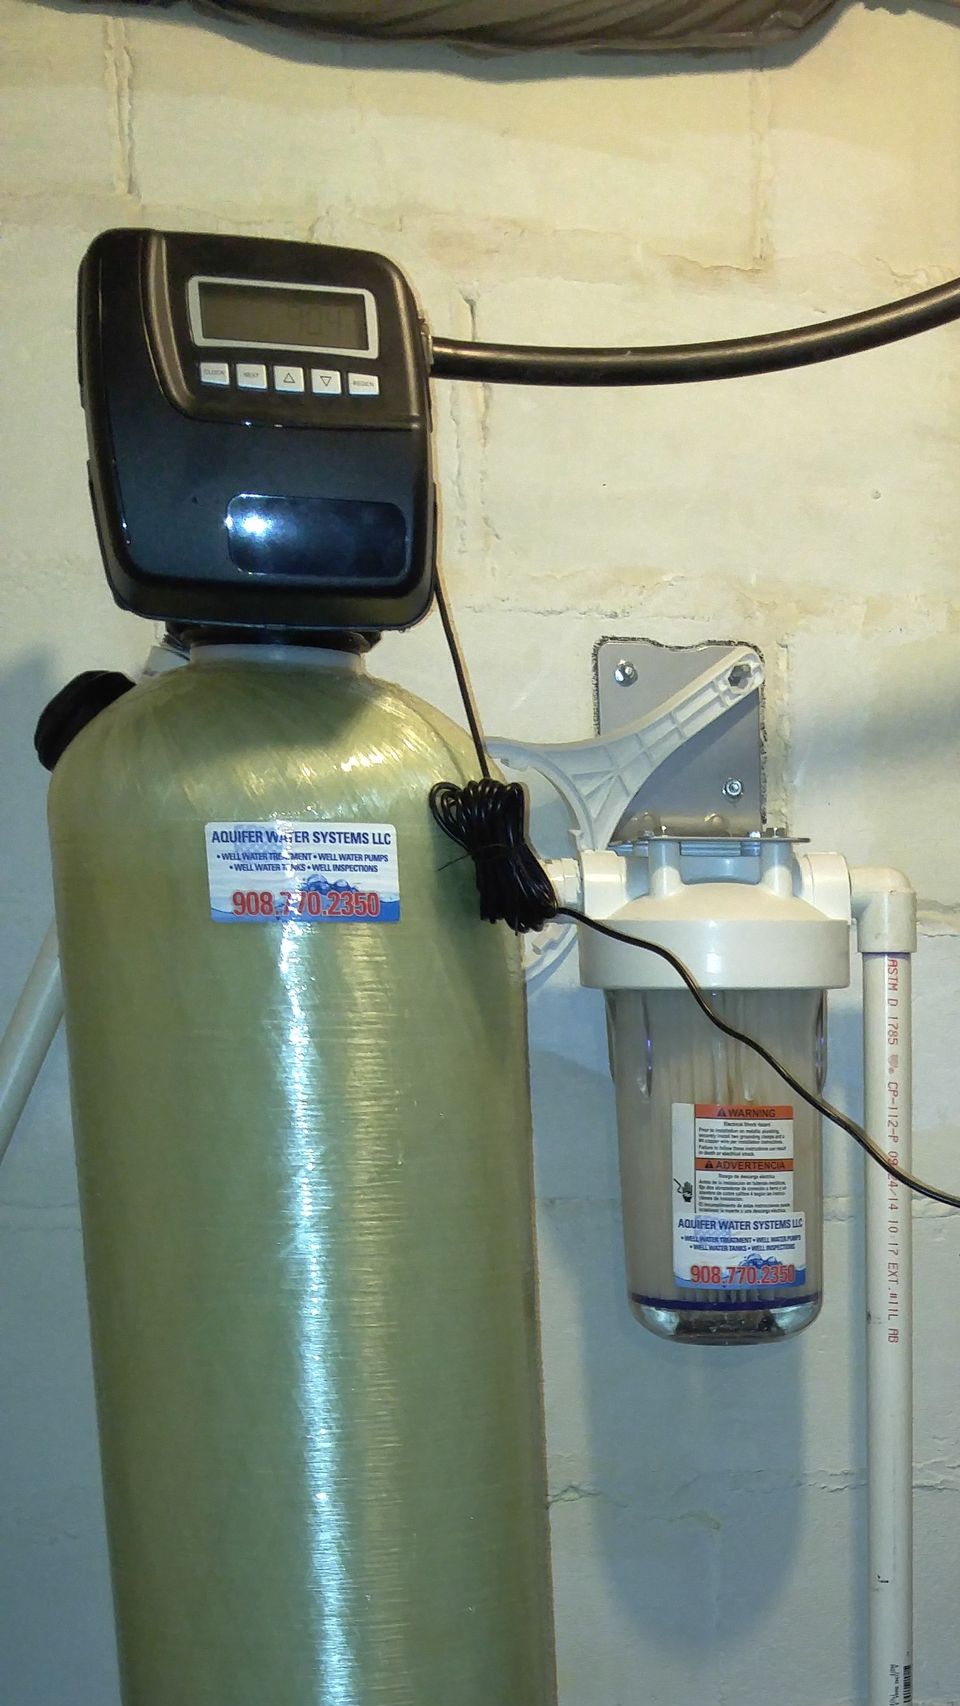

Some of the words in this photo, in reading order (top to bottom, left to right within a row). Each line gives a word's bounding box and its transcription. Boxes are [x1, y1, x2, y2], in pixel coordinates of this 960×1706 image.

[212, 831, 263, 843] AQUIFER
[312, 832, 370, 845] SYSTEMS
[372, 833, 391, 845] LLC
[221, 853, 241, 861] WELL
[242, 853, 268, 861] WATER
[316, 853, 337, 861] WELL
[339, 853, 363, 862] WATER
[364, 854, 389, 862] PUMPS
[235, 863, 253, 872] WELL
[253, 863, 281, 872] WATER
[312, 864, 332, 872] WELL
[332, 864, 378, 873] INSPECTIONS
[232, 891, 380, 916] 908.770.2350
[887, 959, 899, 992] ASTM
[887, 999, 899, 1007] D
[887, 1016, 899, 1046] 1785
[728, 1109, 776, 1117] WARNING
[887, 1082, 899, 1144] CP-112-P
[716, 1161, 785, 1170] ADVERTENCIA
[887, 1151, 899, 1210] 0924/14
[678, 1219, 717, 1230] AQUIFER
[718, 1220, 751, 1230] WATER
[753, 1219, 791, 1230] SYSTEMS
[792, 1218, 803, 1228] LLC
[690, 1264, 795, 1285] 908.770.2350
[887, 1328, 899, 1344] AB
